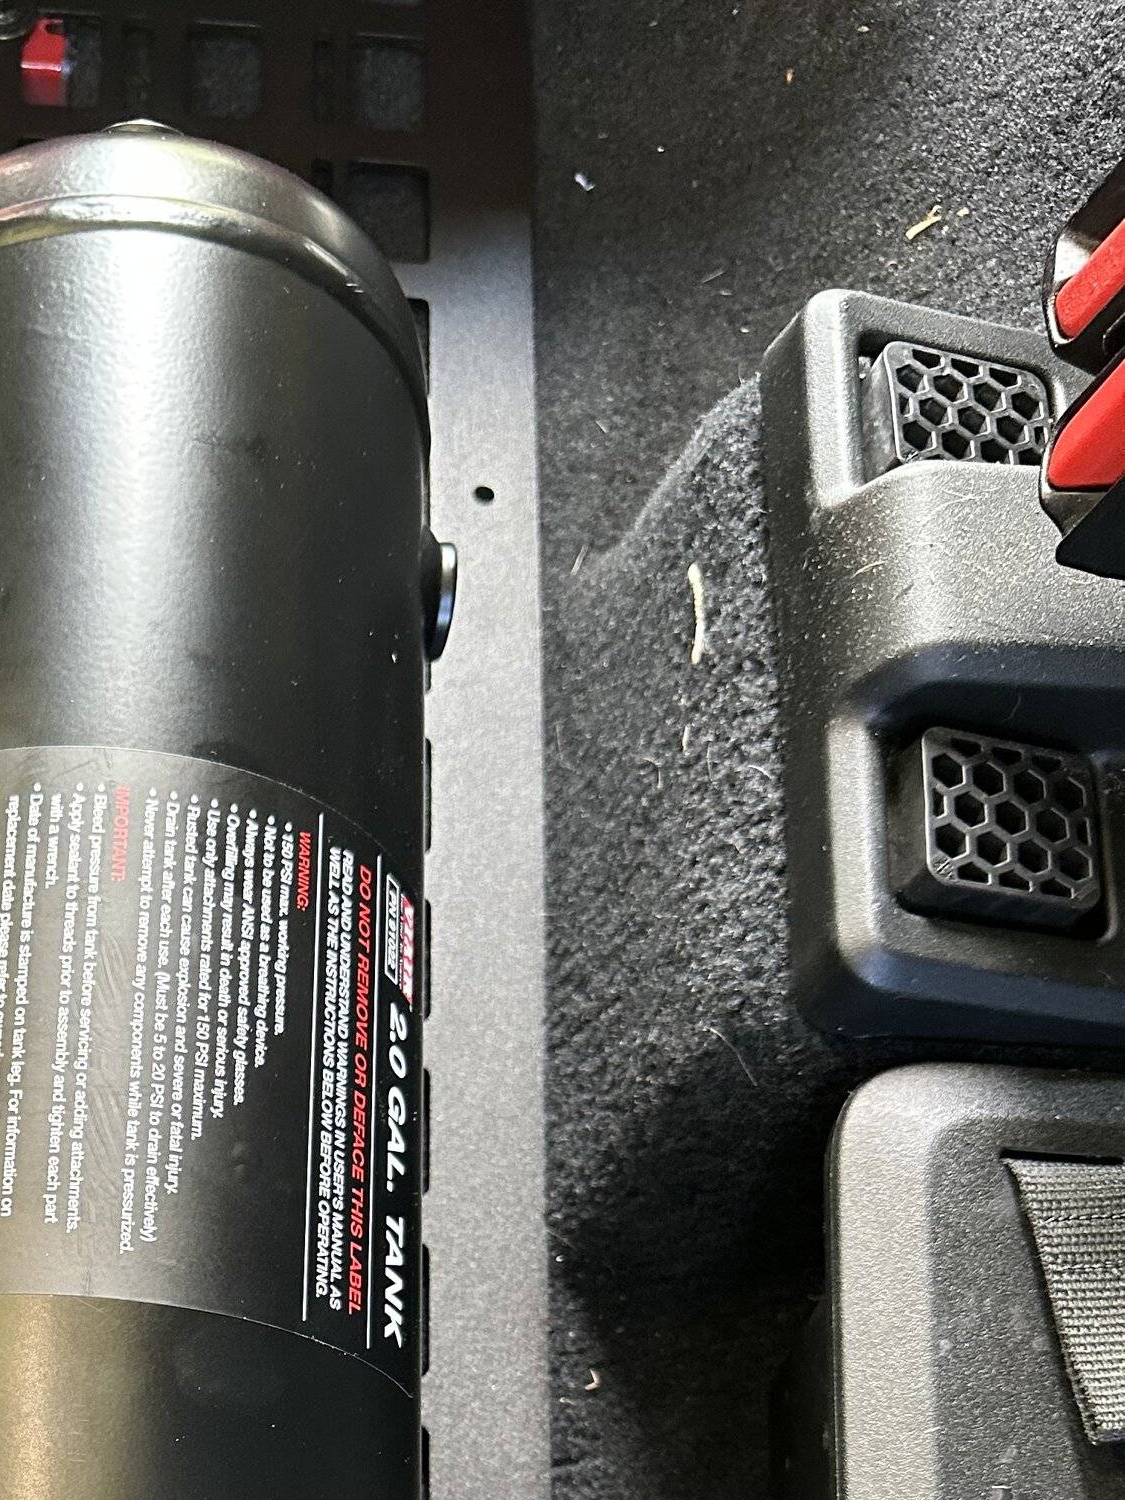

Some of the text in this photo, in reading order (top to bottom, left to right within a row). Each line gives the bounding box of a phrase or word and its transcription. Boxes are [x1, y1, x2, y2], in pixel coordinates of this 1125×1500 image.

[1, 880, 16, 910] date
[4, 794, 21, 878] replacement
[45, 792, 64, 888] with a wrench.
[112, 786, 129, 881] IMPORTANT:
[191, 809, 220, 1139] Use only attachments rated for 150 PSI maximum.
[210, 814, 240, 1117] Overfilling may result in death or serious injury.
[233, 818, 258, 1104] Always wear ANSI approved safety glasses.
[254, 824, 276, 1067] Not to be used as a breathing device.
[274, 833, 293, 1034] 150 PSI max. working pressure.
[298, 832, 310, 910] WARNING:
[387, 890, 399, 918] PN
[1, 792, 43, 1216] Date of manufacture is stamped on tank leg. For information on
[43, 792, 86, 1222] Apply sealant to threads prior to assembly and tighten each part
[67, 793, 107, 1232] Bleed pressure from tank before servicing or adding attachments.
[120, 798, 159, 1253] Never attempt to remove any components while tank is pressurized.
[140, 801, 180, 1241] Drain tank after each use. (Must be 5 to 20 PSI to drain effectively)
[164, 804, 200, 1194] Rusted tank can cause explosion and severe or fatal injury.
[316, 847, 341, 1298] WELL AS THE INSTRUCTIONS BELOW BEFORE OPERATING.
[330, 850, 353, 1309] READ AND UNDERSTAND WARNINGS IN USER'S MANUAL AS
[349, 865, 372, 1314] DO NOT REMOVE OR DEFACE THIS LABEL
[385, 1003, 407, 1348] 2.0 GAL. TANK
